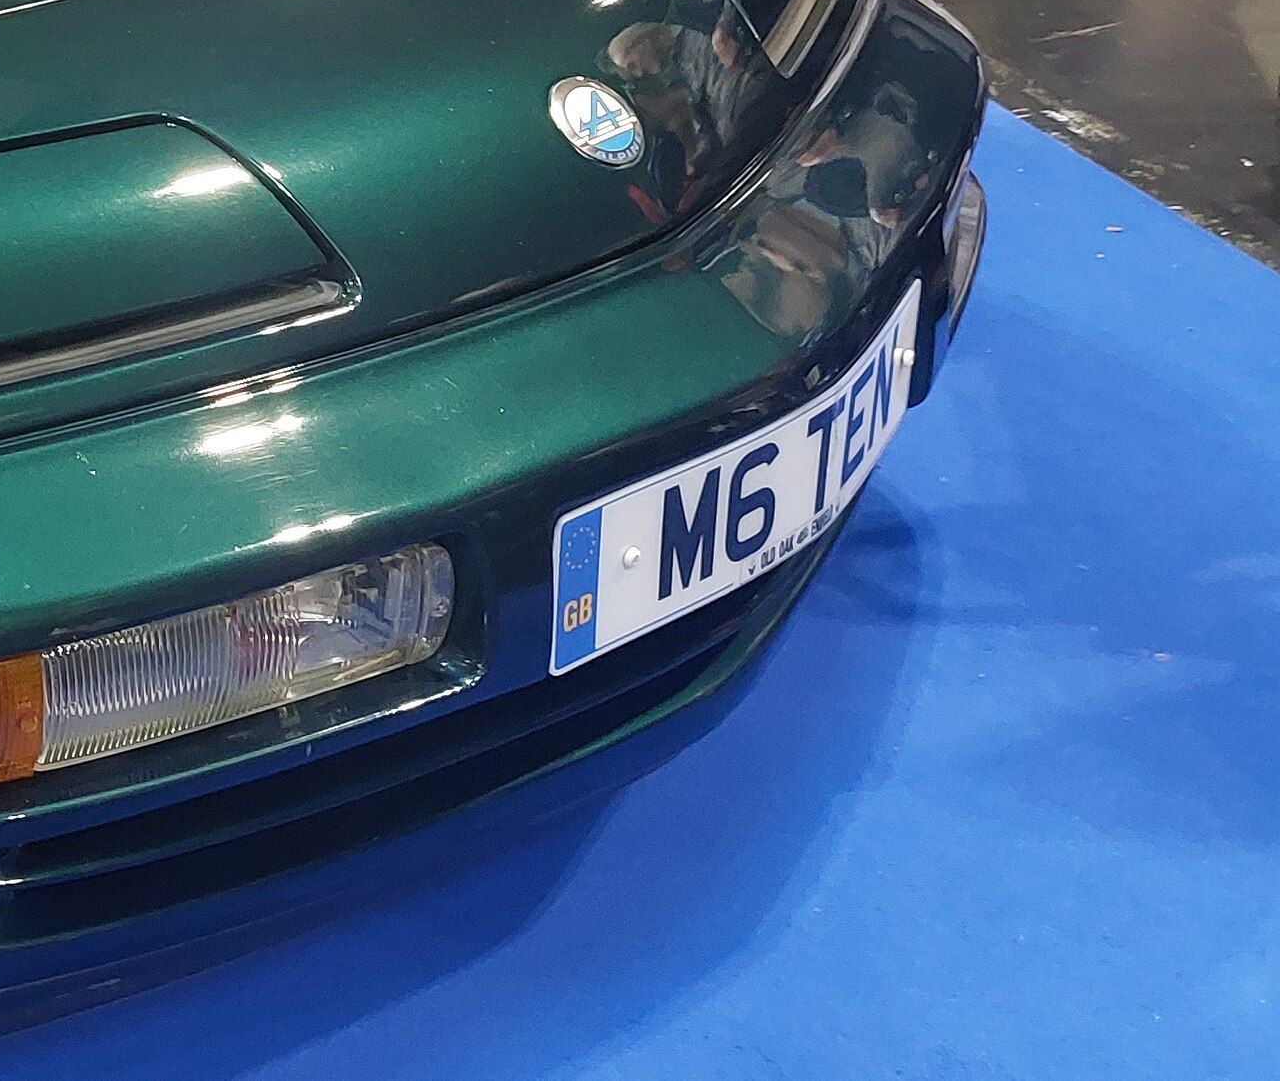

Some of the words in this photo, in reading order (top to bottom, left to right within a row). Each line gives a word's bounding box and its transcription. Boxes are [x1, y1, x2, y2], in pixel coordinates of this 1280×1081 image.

[657, 442, 780, 601] M6
[807, 324, 900, 515] TEN
[563, 593, 593, 632] GB
